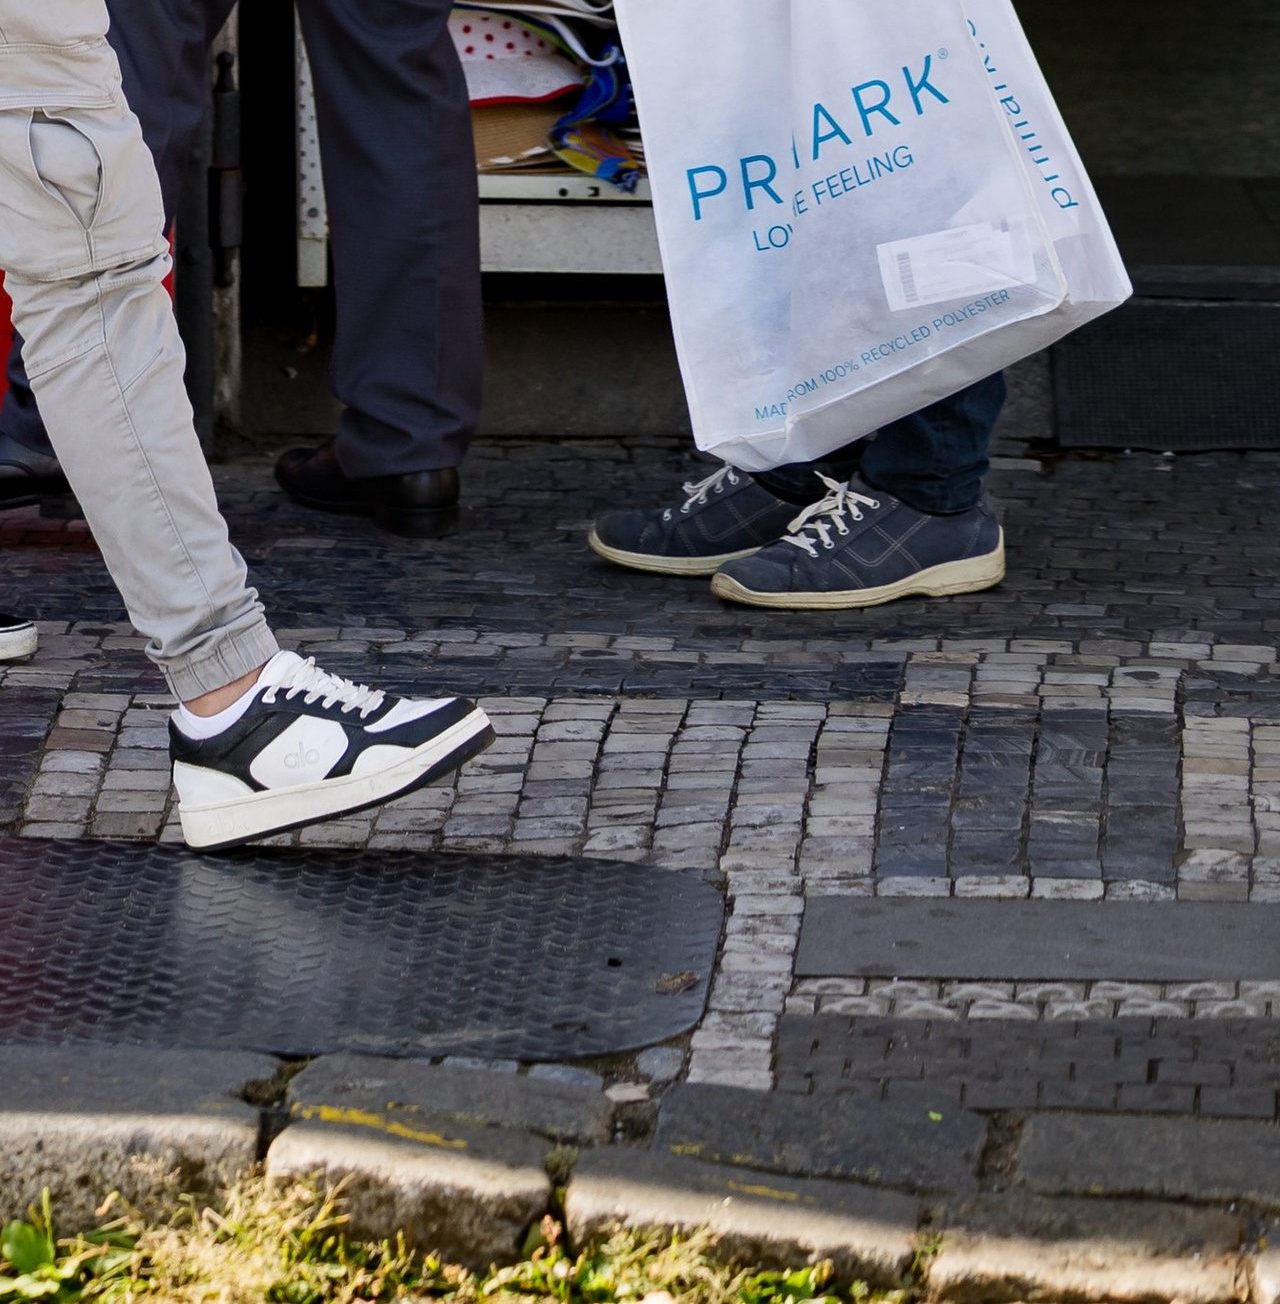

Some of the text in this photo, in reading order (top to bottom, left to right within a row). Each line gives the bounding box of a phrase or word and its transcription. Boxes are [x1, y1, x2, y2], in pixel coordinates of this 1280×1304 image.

[812, 144, 915, 205] FEELING
[819, 358, 860, 385] 100%
[860, 324, 931, 366] RECYCLED
[932, 288, 1012, 332] POLYESTER
[283, 740, 320, 769] alo
